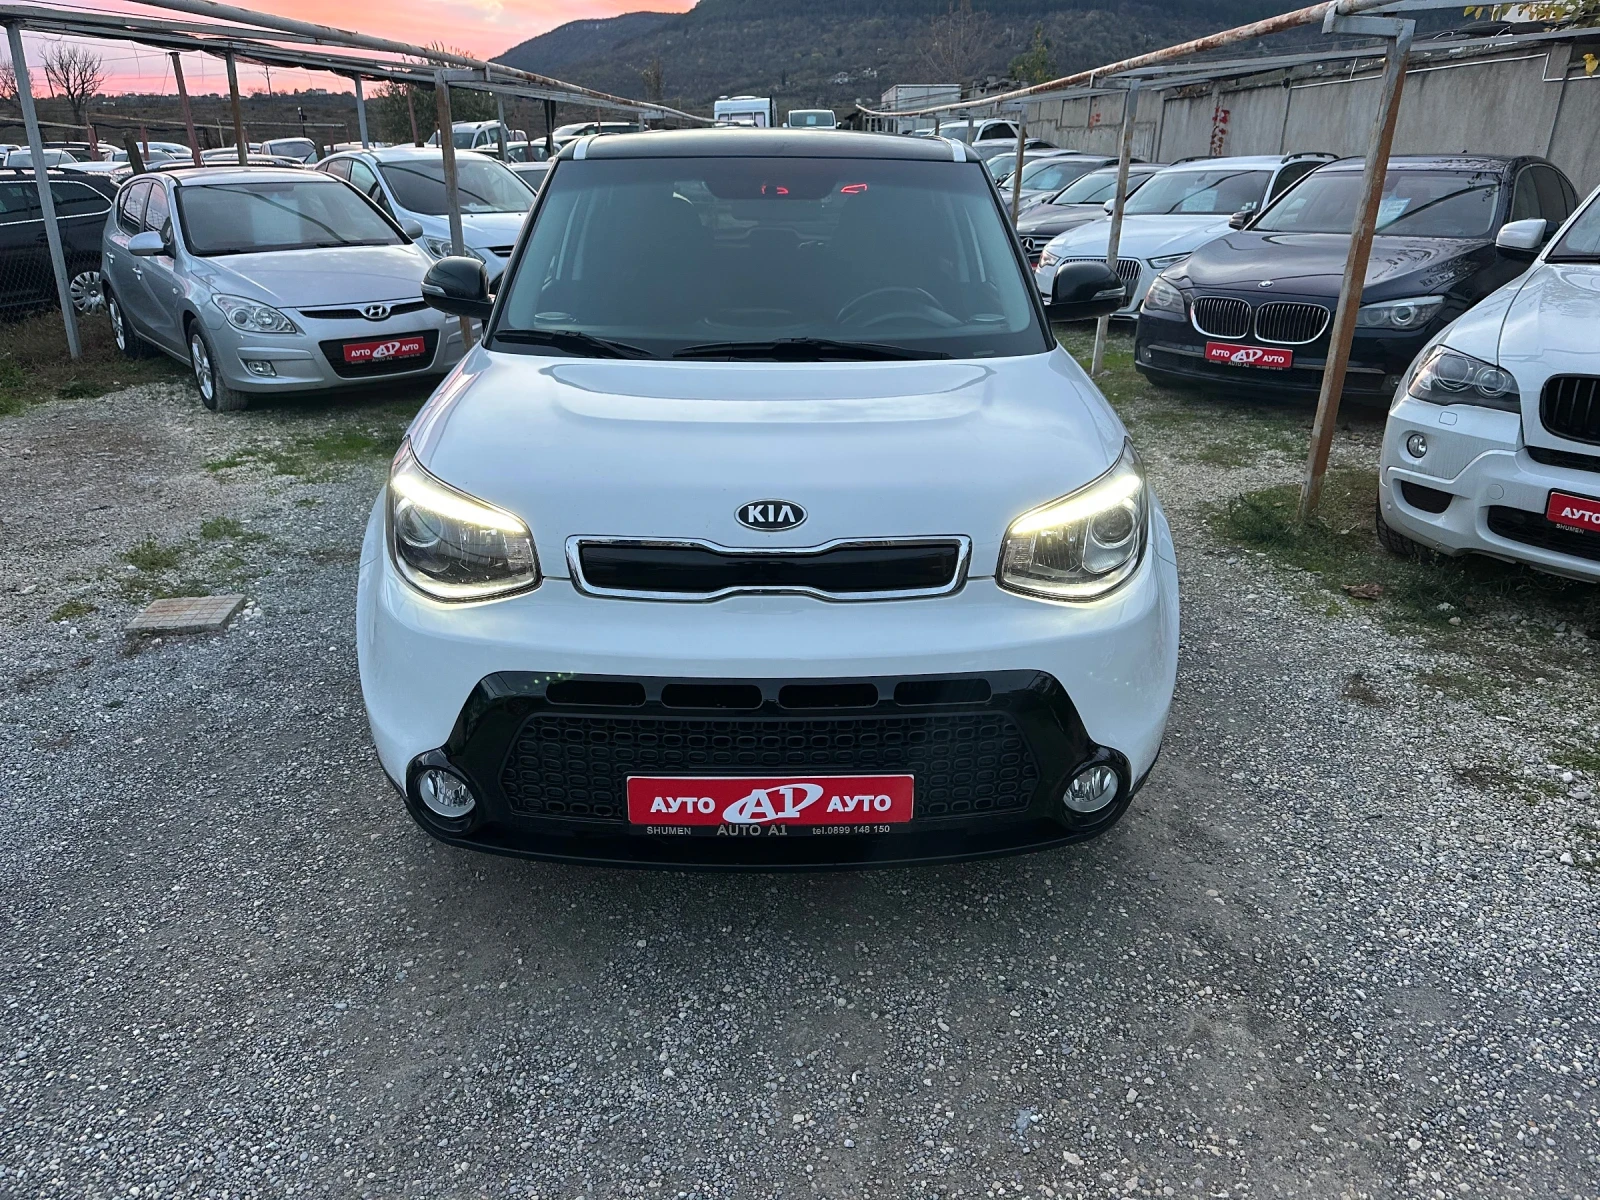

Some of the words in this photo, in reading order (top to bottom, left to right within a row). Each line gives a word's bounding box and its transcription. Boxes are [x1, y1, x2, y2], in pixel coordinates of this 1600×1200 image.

[747, 504, 796, 523] KIA
[1555, 523, 1585, 534] SHUMEN
[646, 826, 692, 835] SHUMEN
[716, 824, 762, 836] AUTO
[768, 824, 788, 836] A1
[812, 826, 850, 835] tel.0899
[853, 825, 870, 834] 148
[873, 825, 890, 833] 150
